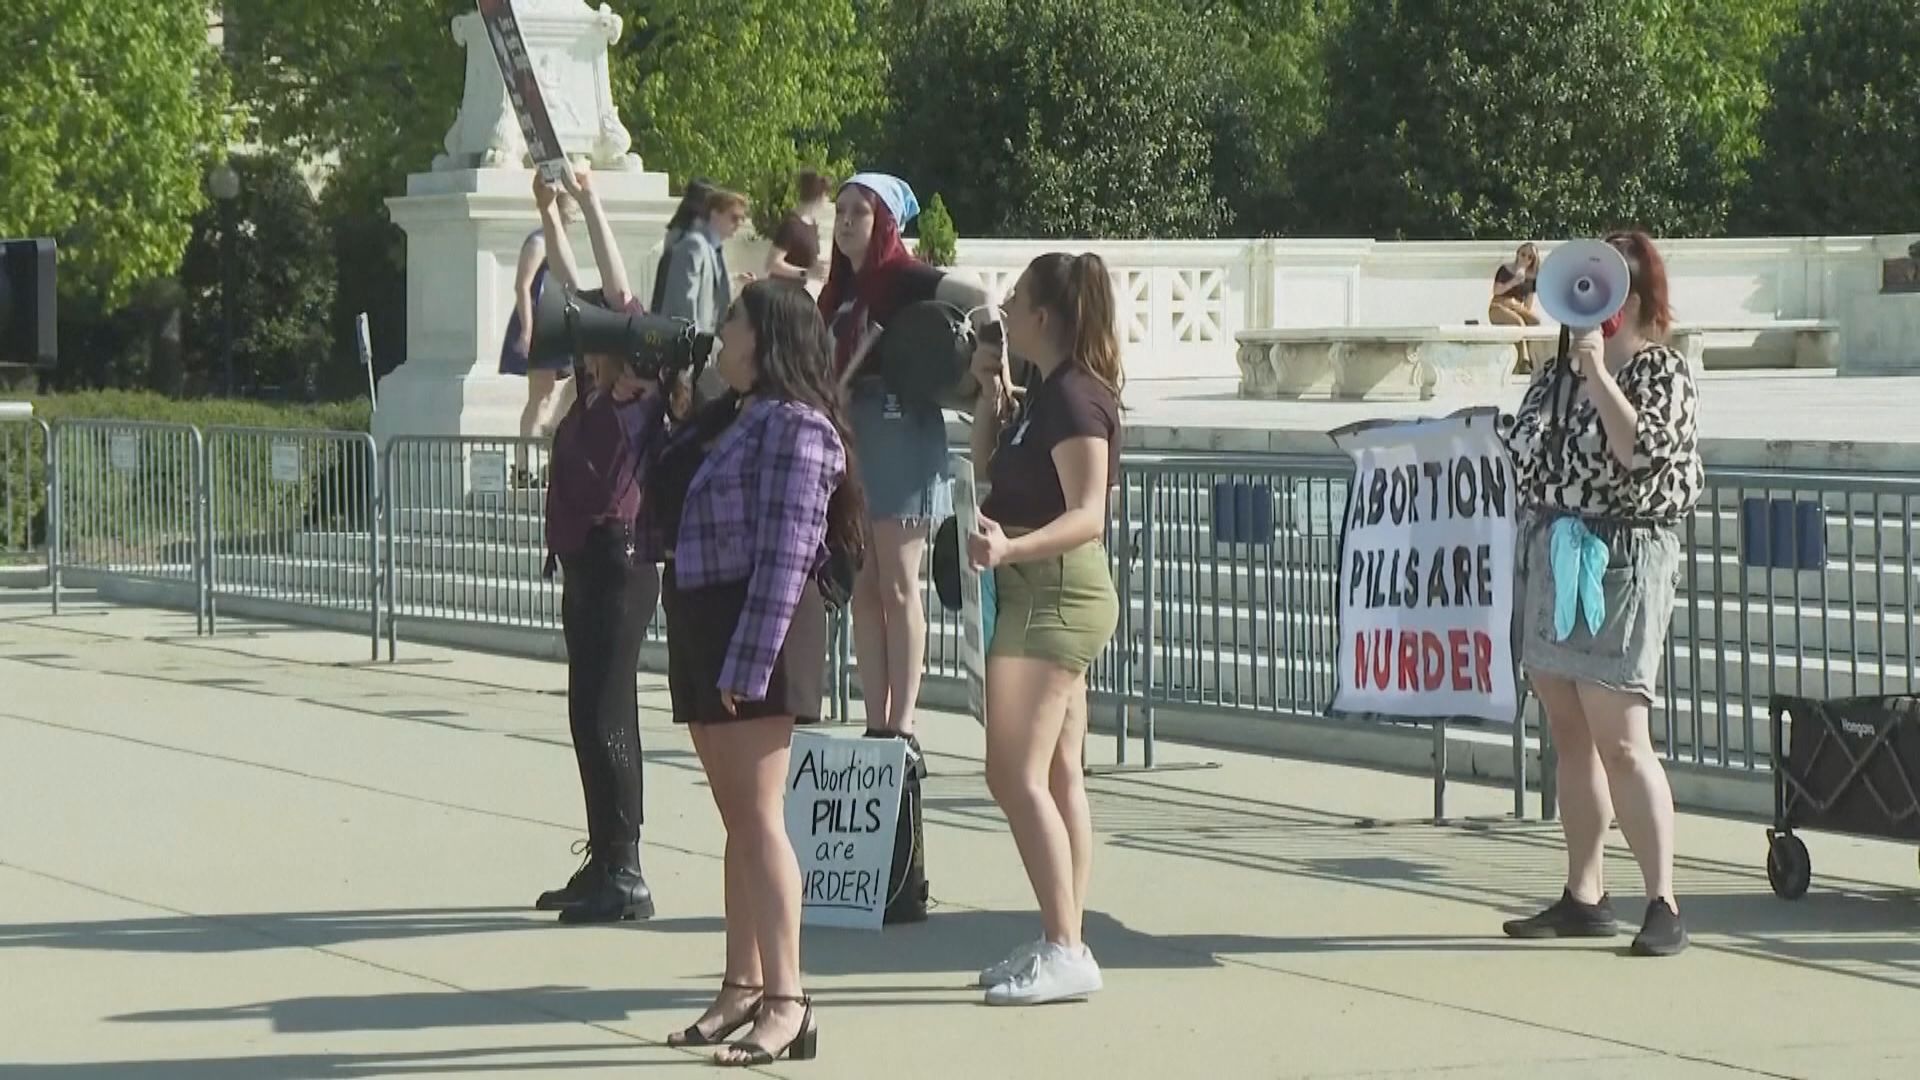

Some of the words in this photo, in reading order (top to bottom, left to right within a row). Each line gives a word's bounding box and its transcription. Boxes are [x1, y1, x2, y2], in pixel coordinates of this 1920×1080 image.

[1352, 455, 1505, 530] ABORTION
[1350, 548, 1419, 609] PILLS
[1427, 544, 1493, 608] ARE
[792, 749, 894, 793] Abortion
[811, 799, 880, 836] PILLS
[815, 841, 854, 861] are
